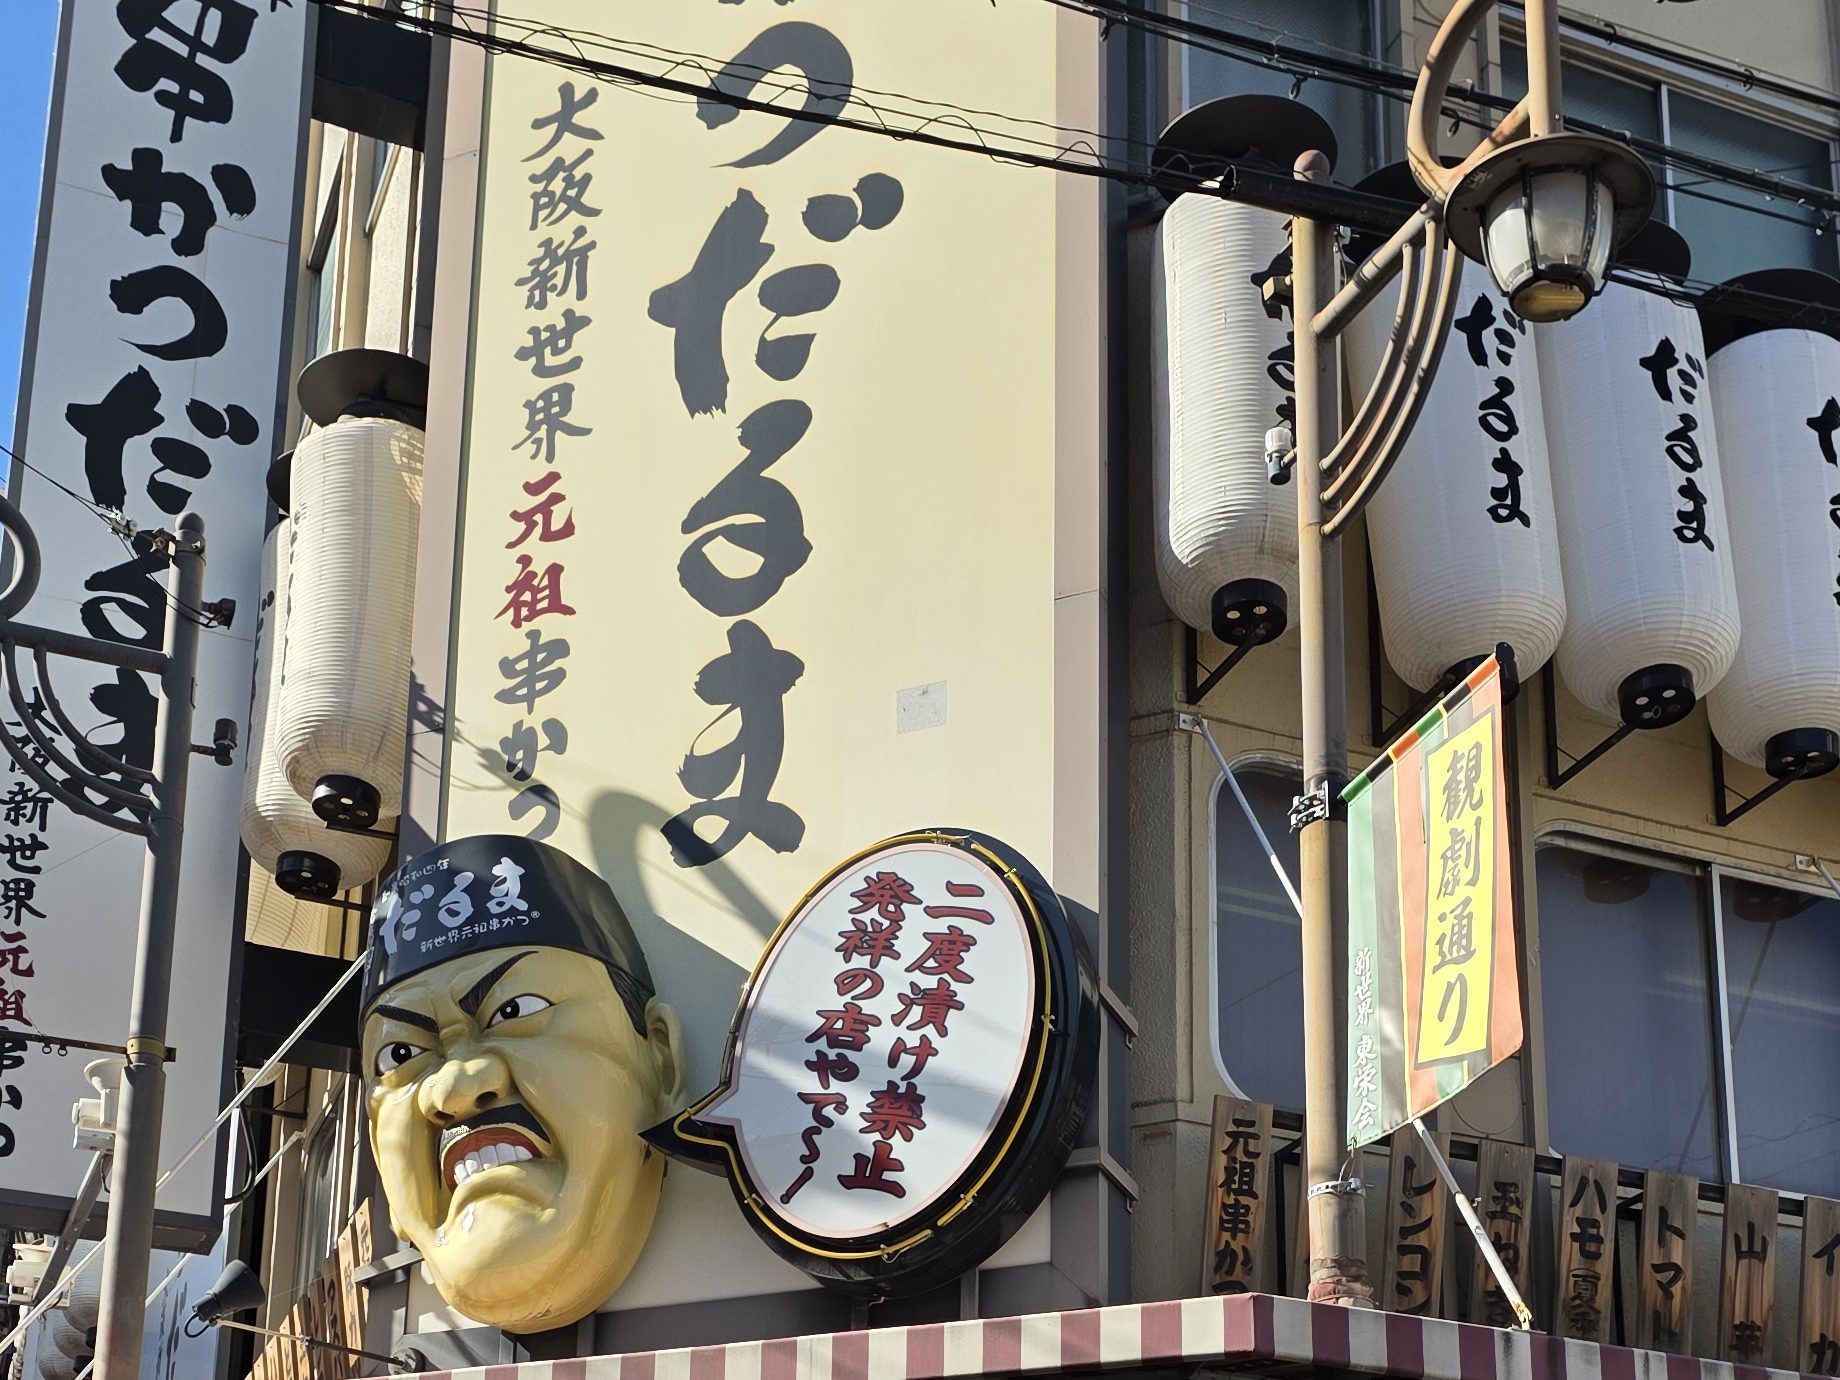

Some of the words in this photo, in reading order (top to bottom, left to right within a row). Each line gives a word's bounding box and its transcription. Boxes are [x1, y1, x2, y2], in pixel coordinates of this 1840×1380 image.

[494, 81, 605, 843] 大阪新世界元祖串かつ
[647, 0, 904, 868] つだるま
[1454, 293, 1531, 528] だるま
[1638, 336, 1715, 552] だるま
[379, 856, 528, 955] だるま
[1354, 947, 1374, 1027] 新世界
[1432, 740, 1485, 1049] 観劇通り
[838, 880, 996, 1199] 二度漬け禁止
[1353, 1034, 1377, 1131] 東栄会
[1395, 1155, 1437, 1315] レンコン
[1650, 1205, 1687, 1345] トマト
